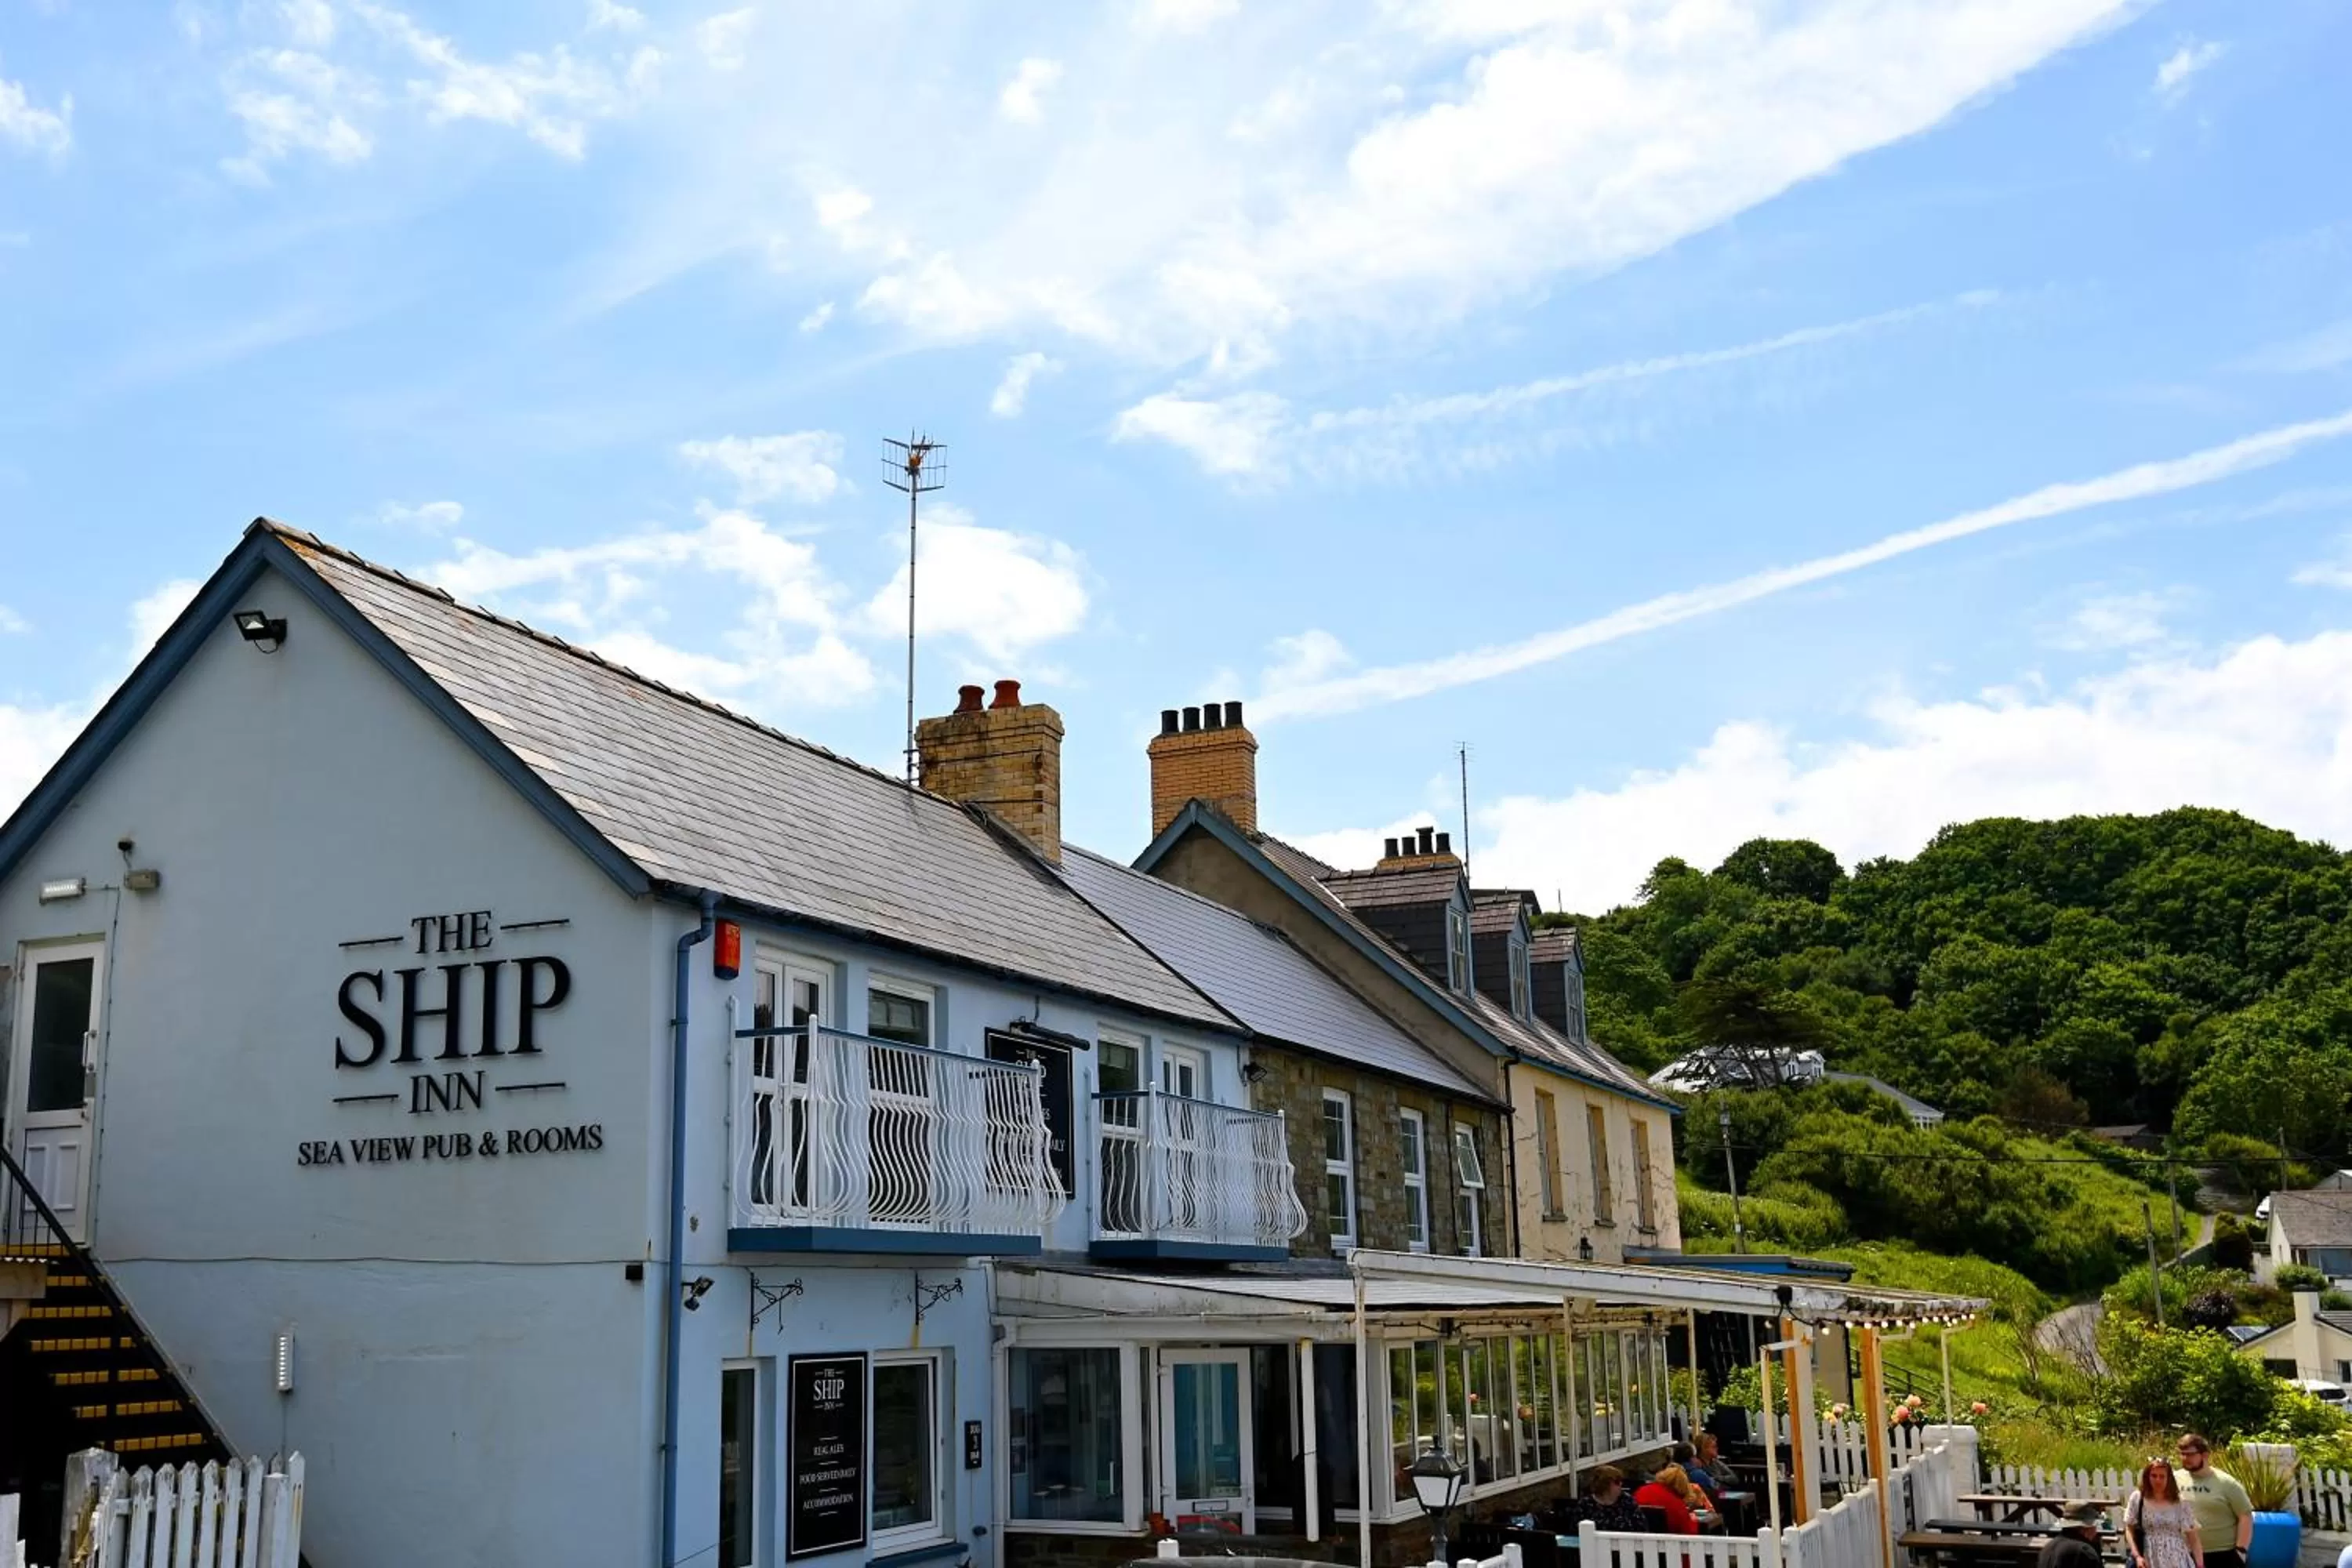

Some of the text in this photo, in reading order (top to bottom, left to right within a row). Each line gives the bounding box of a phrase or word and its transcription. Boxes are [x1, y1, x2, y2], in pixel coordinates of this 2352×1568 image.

[412, 910, 494, 955] THE
[335, 956, 572, 1069] SHIP
[407, 1069, 486, 1116] INN
[298, 1124, 604, 1167] SEA VIEW PUB & ROOMS
[813, 1379, 844, 1401] SHIP
